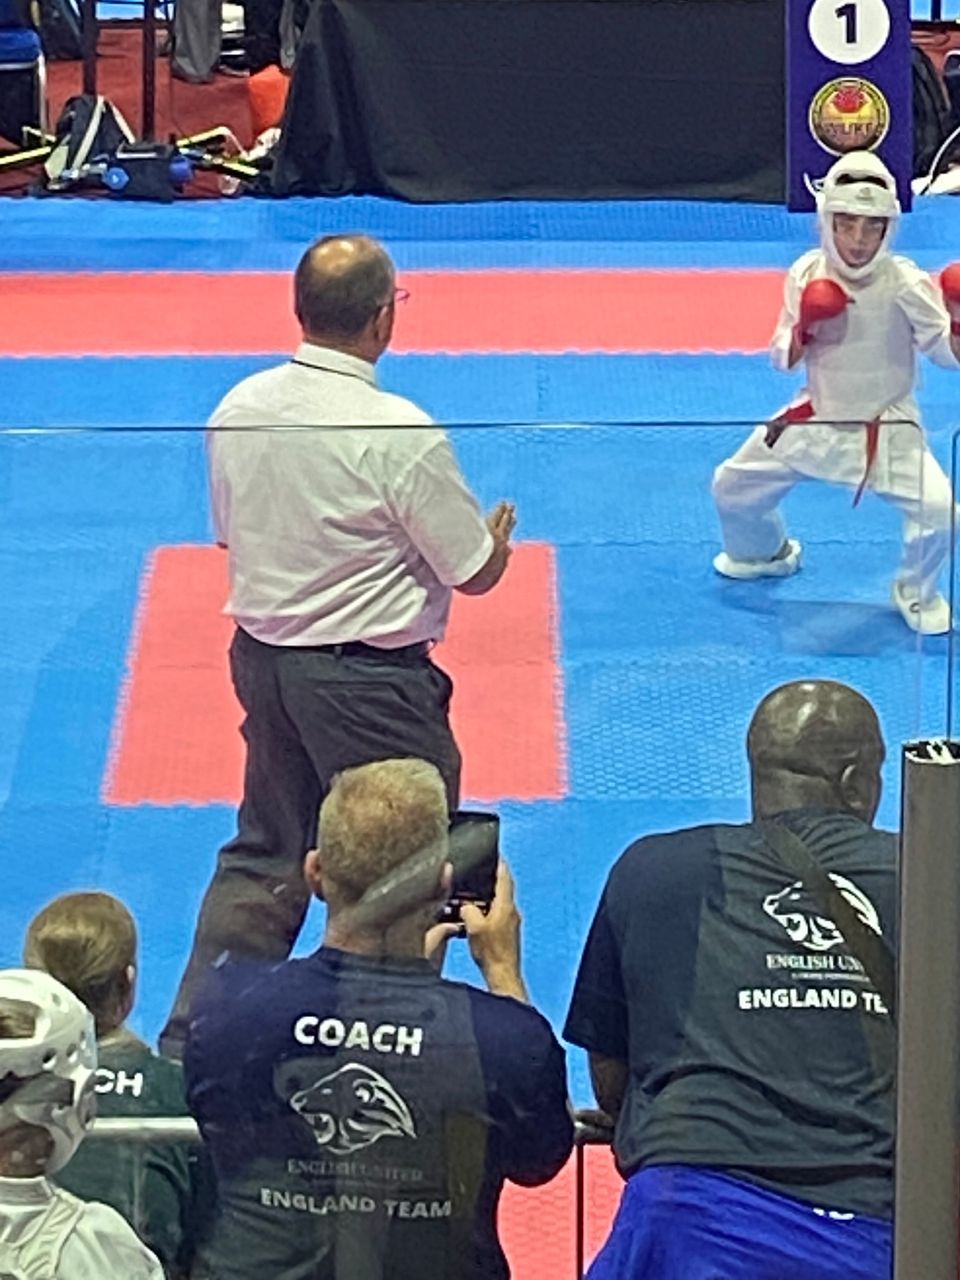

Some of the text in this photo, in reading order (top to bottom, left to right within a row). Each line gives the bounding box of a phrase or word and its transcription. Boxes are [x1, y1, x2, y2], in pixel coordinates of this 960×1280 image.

[835, 2, 858, 44] 1
[766, 954, 834, 970] ENGLISH
[738, 988, 858, 1009] ENGLAND
[293, 1016, 423, 1056] COACH
[261, 1187, 451, 1218] ENGLAND TEAM
